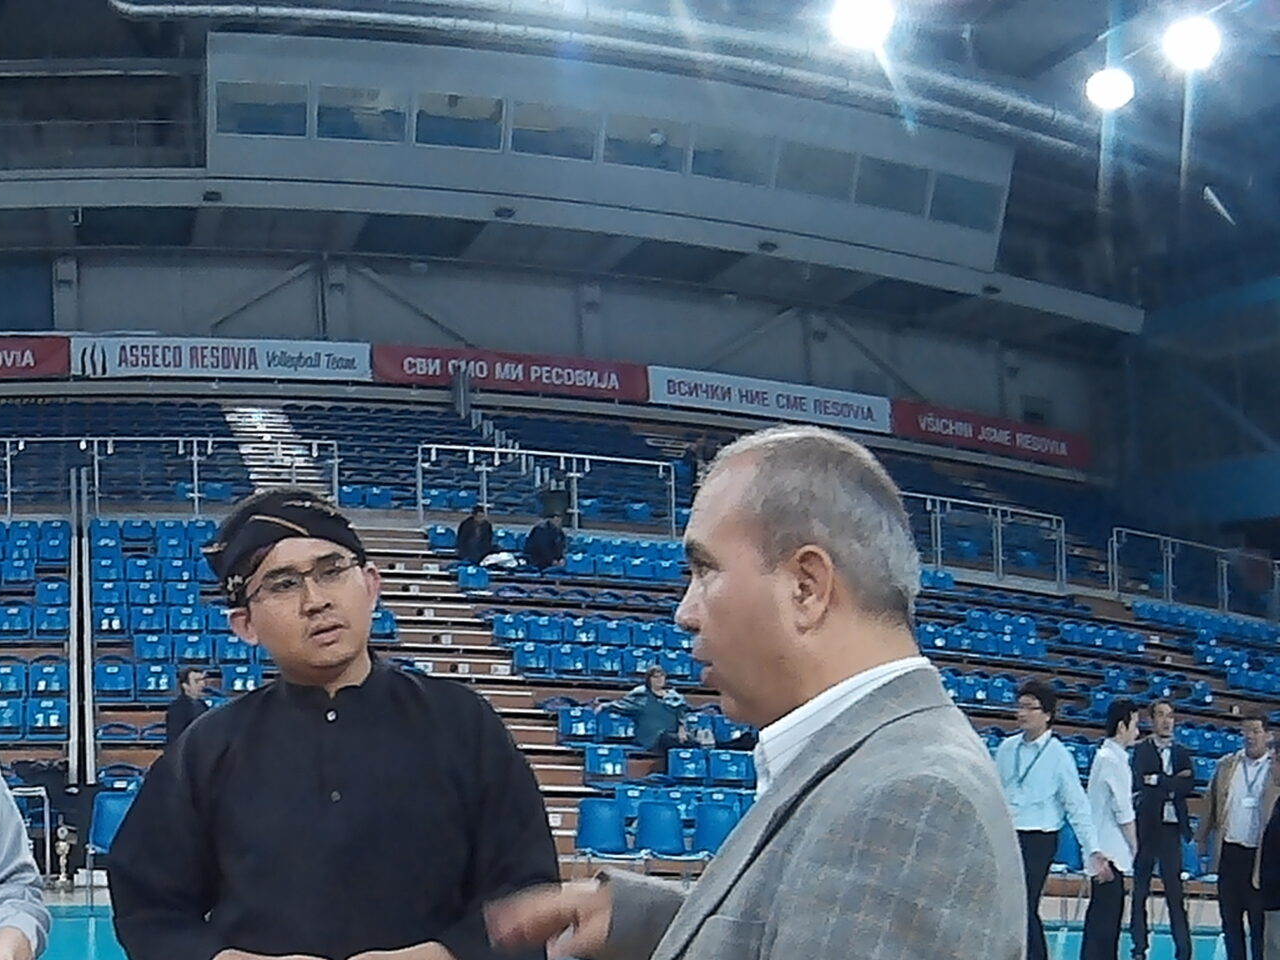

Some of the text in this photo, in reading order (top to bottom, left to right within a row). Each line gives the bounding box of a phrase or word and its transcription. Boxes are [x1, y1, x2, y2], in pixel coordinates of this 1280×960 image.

[117, 345, 359, 372] ASSECO RESOVIA Volleyball Team
[813, 398, 877, 422] RESOVIA
